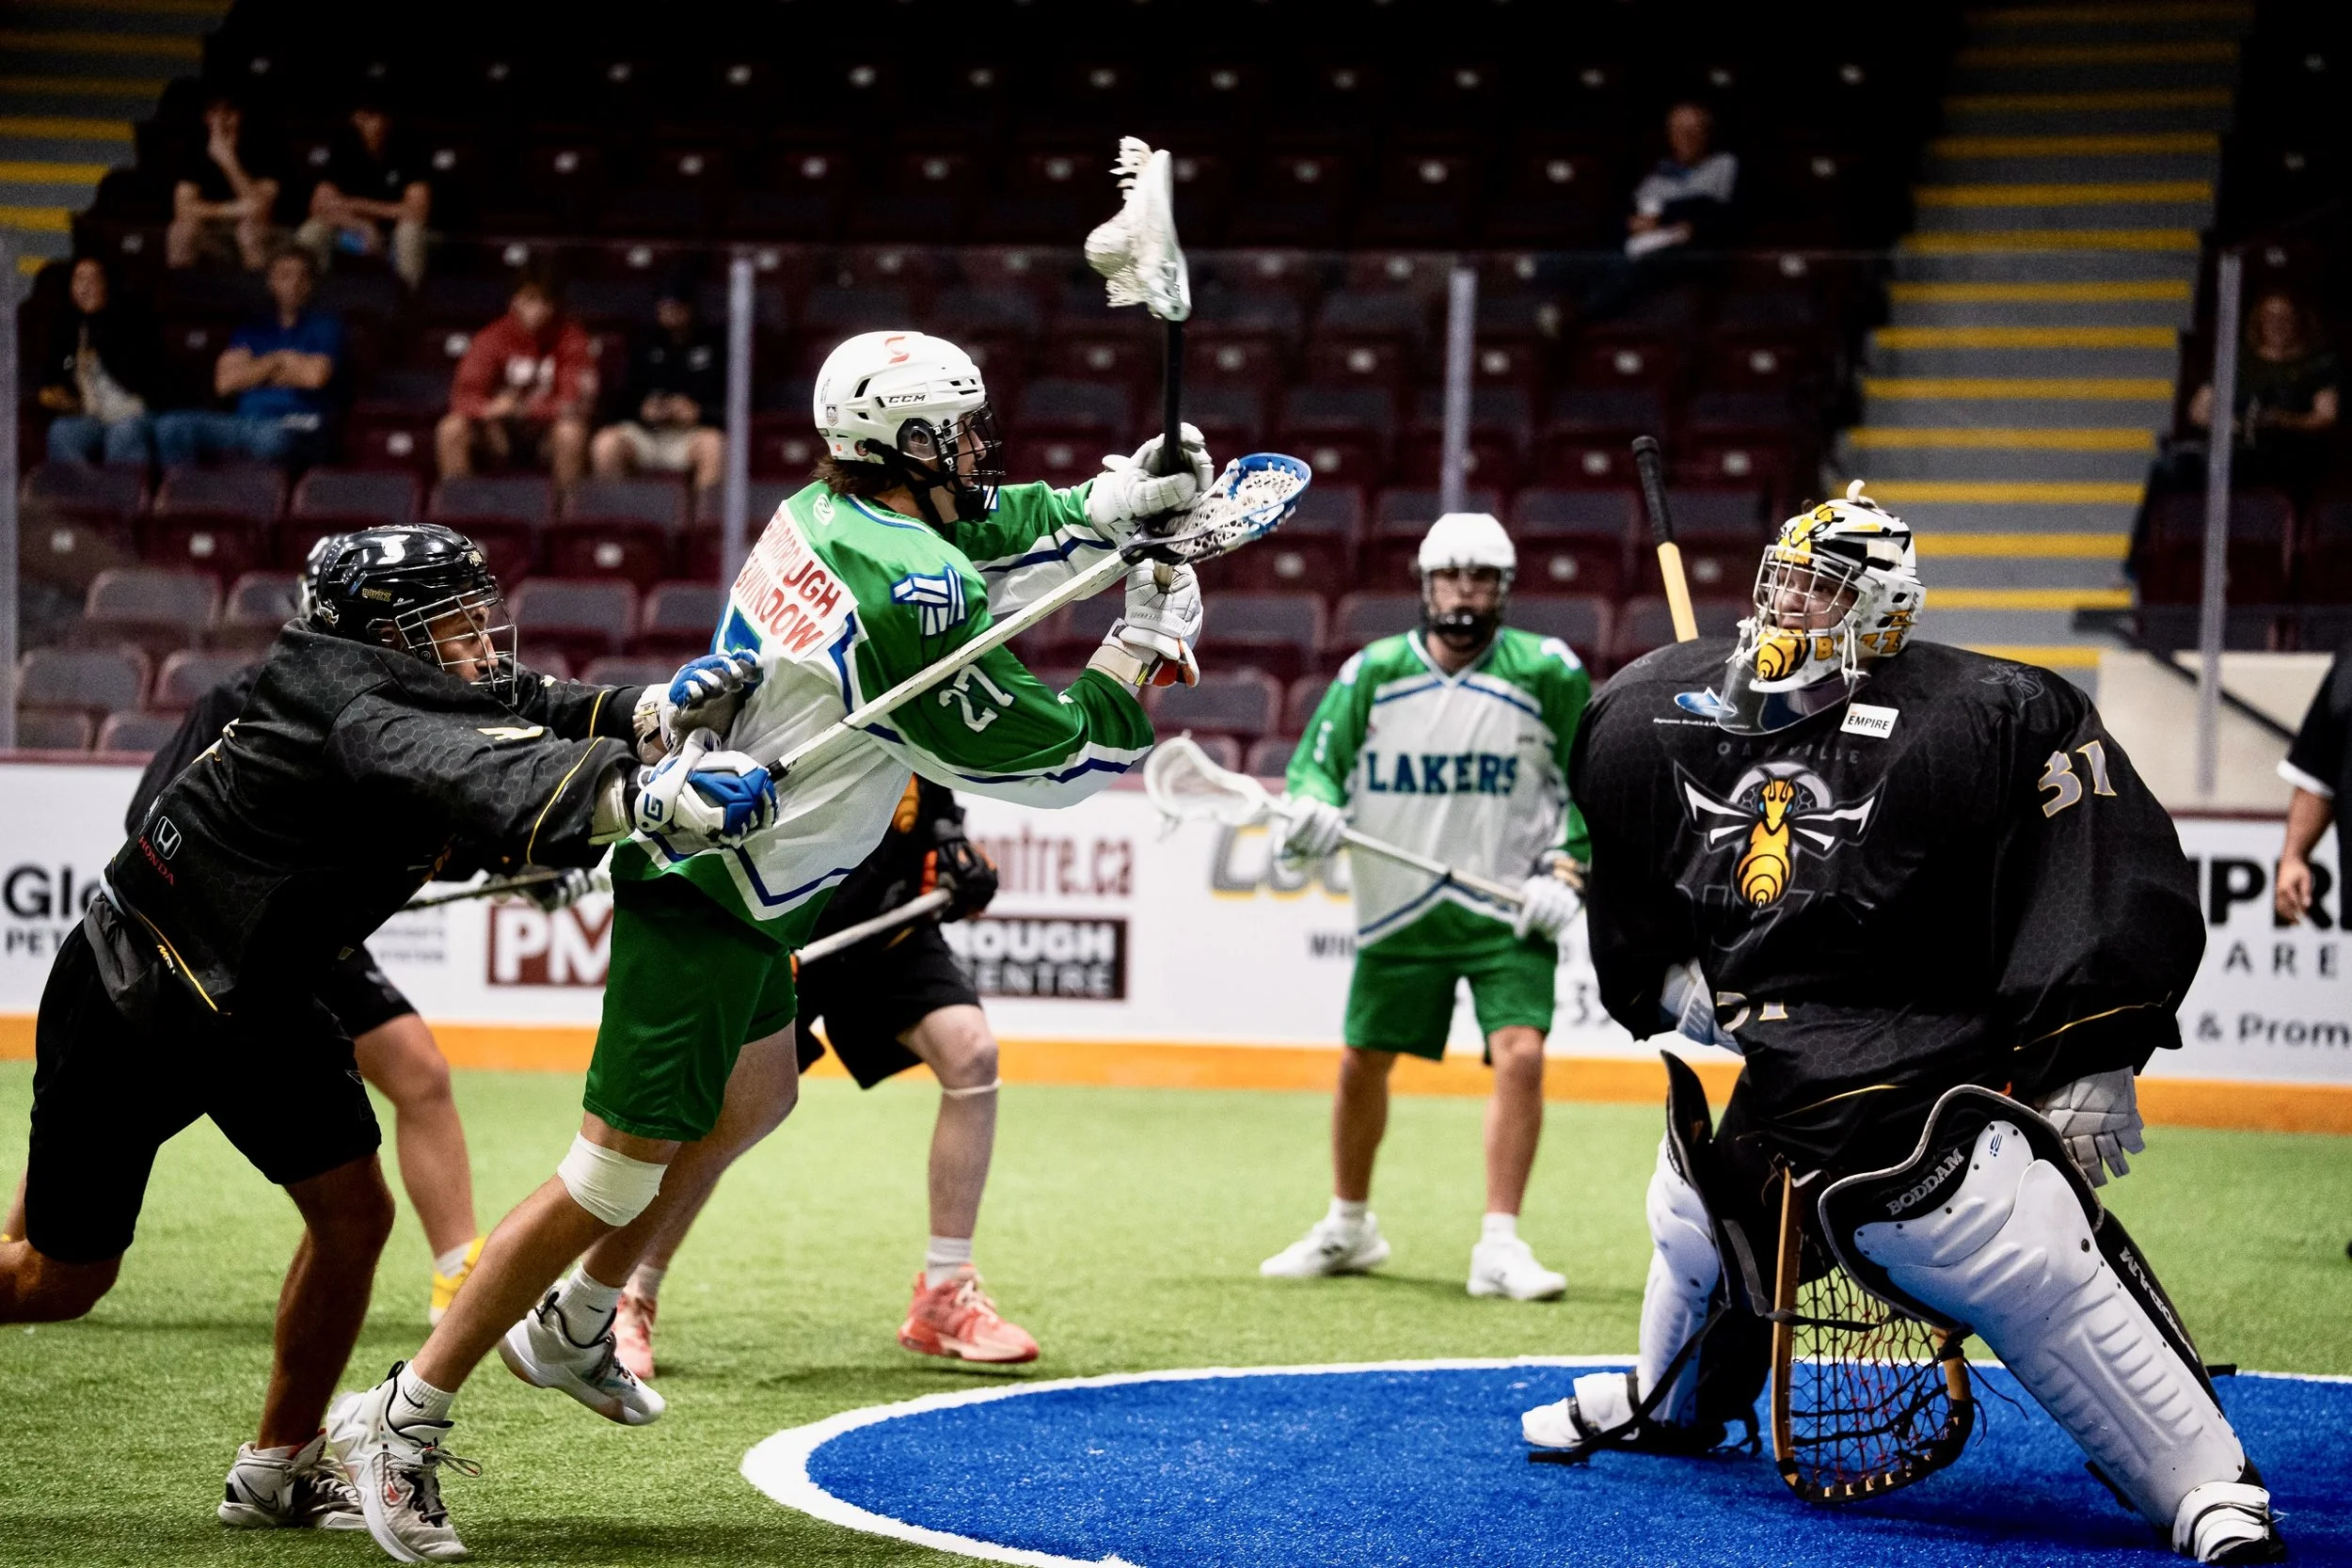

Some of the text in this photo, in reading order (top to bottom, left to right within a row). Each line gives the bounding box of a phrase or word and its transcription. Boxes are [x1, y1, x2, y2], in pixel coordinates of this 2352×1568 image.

[887, 394, 927, 404] CCM
[361, 587, 393, 602] BUZZ
[1814, 629, 1903, 661] BZZ
[938, 663, 1015, 733] 27
[1847, 714, 1890, 732] EMPIRE
[1366, 751, 1518, 797] LAKERS
[2038, 739, 2118, 818] 31
[138, 835, 175, 887] HONDA
[1885, 1148, 1965, 1216] BODDAM
